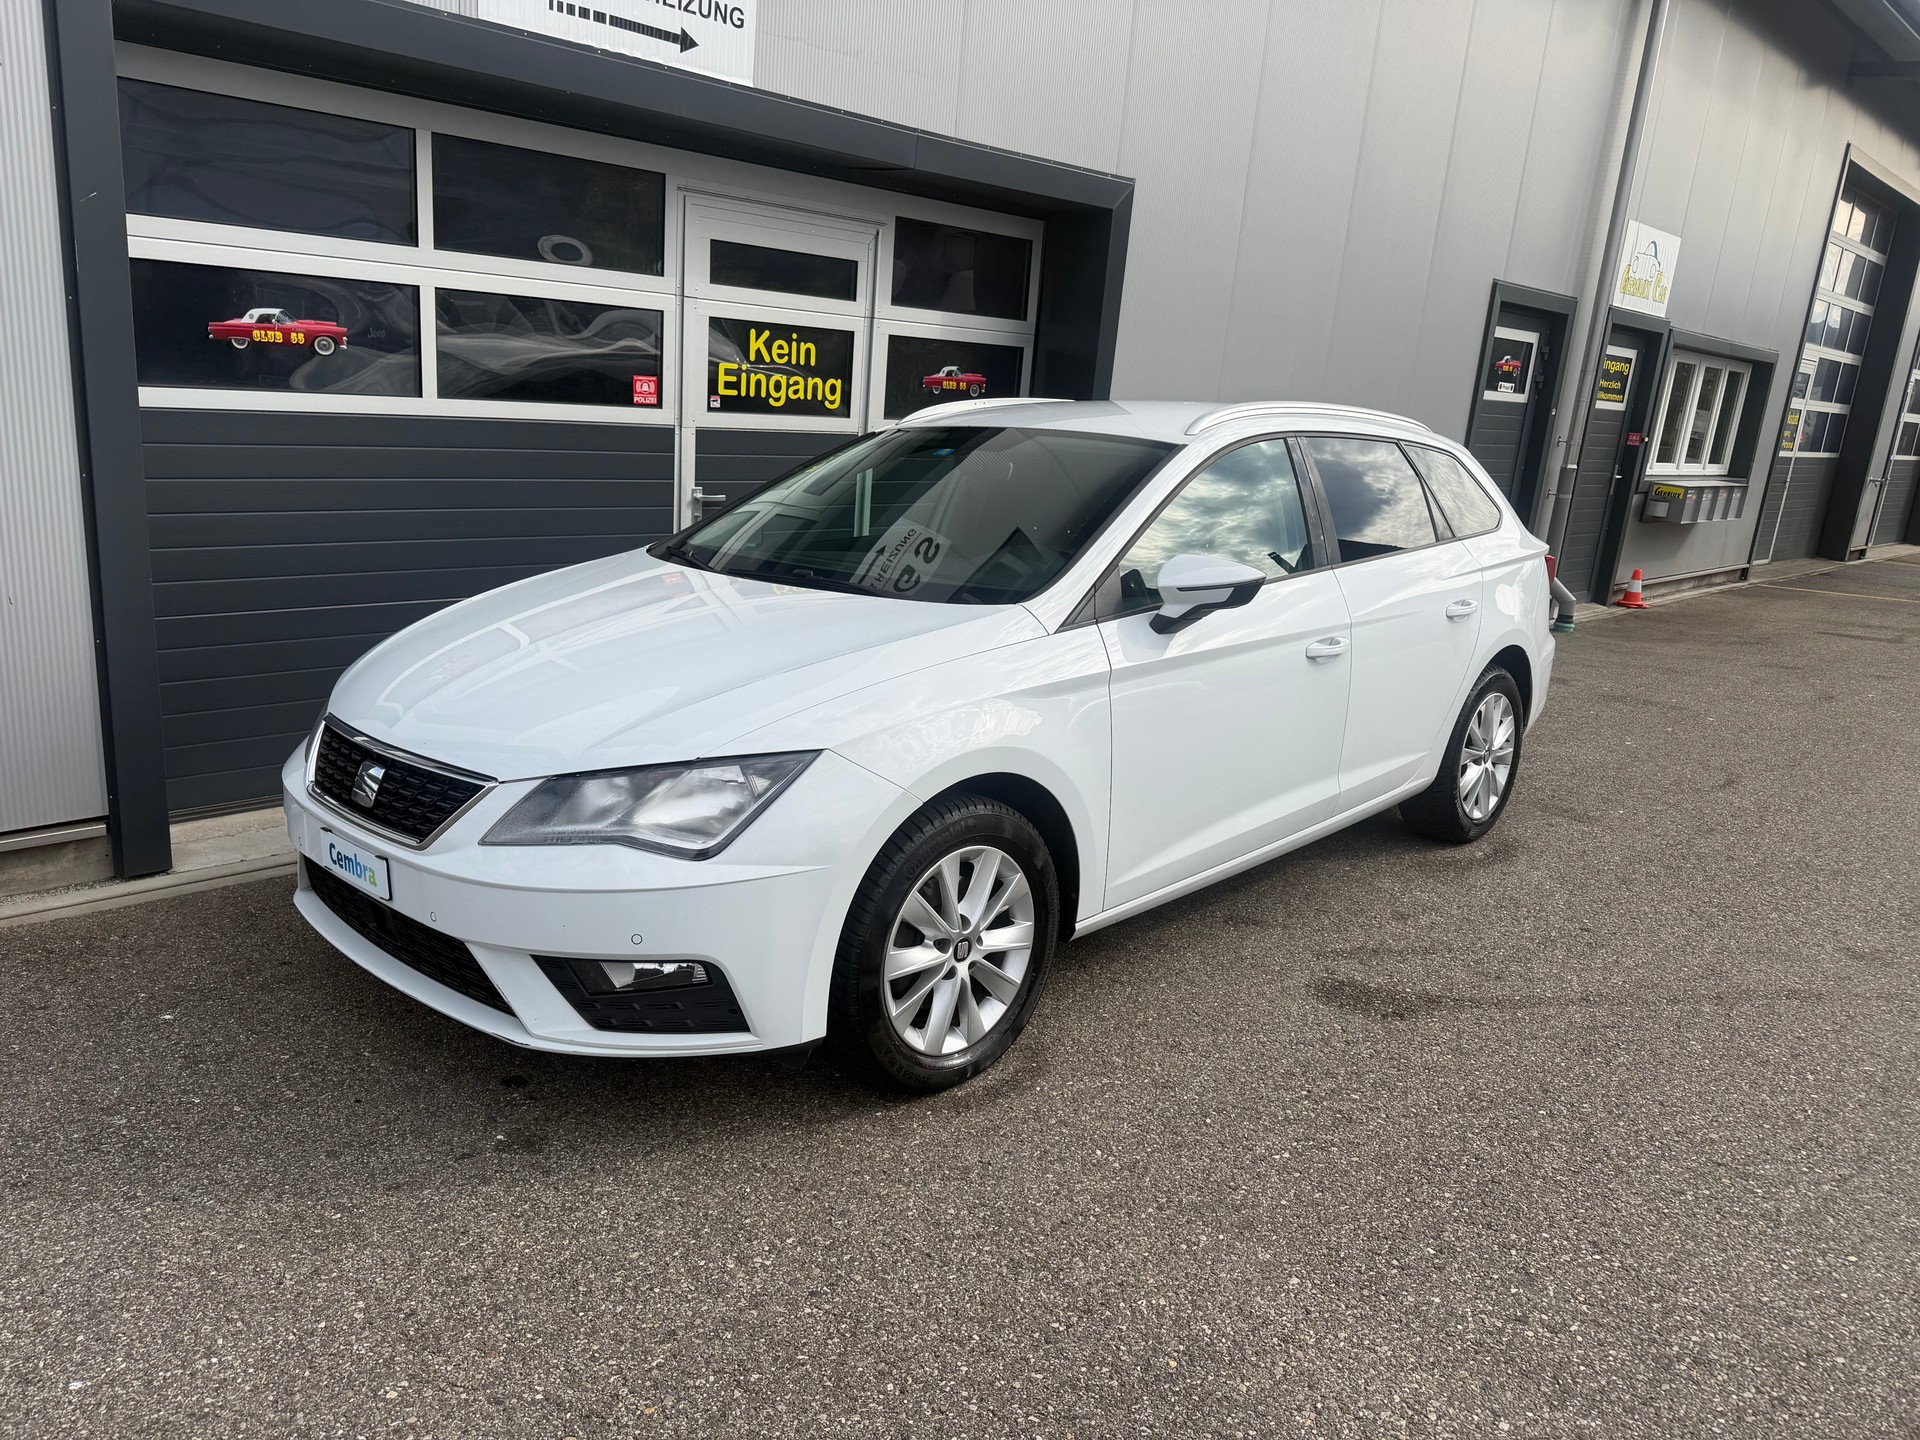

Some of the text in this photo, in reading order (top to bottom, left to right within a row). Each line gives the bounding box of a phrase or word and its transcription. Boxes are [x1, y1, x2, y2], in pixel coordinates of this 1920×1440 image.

[749, 328, 816, 366] Kein
[1603, 357, 1630, 375] ingang
[634, 396, 657, 404] POLIZEI
[718, 362, 842, 409] Eingang
[329, 842, 378, 888] Cembra
